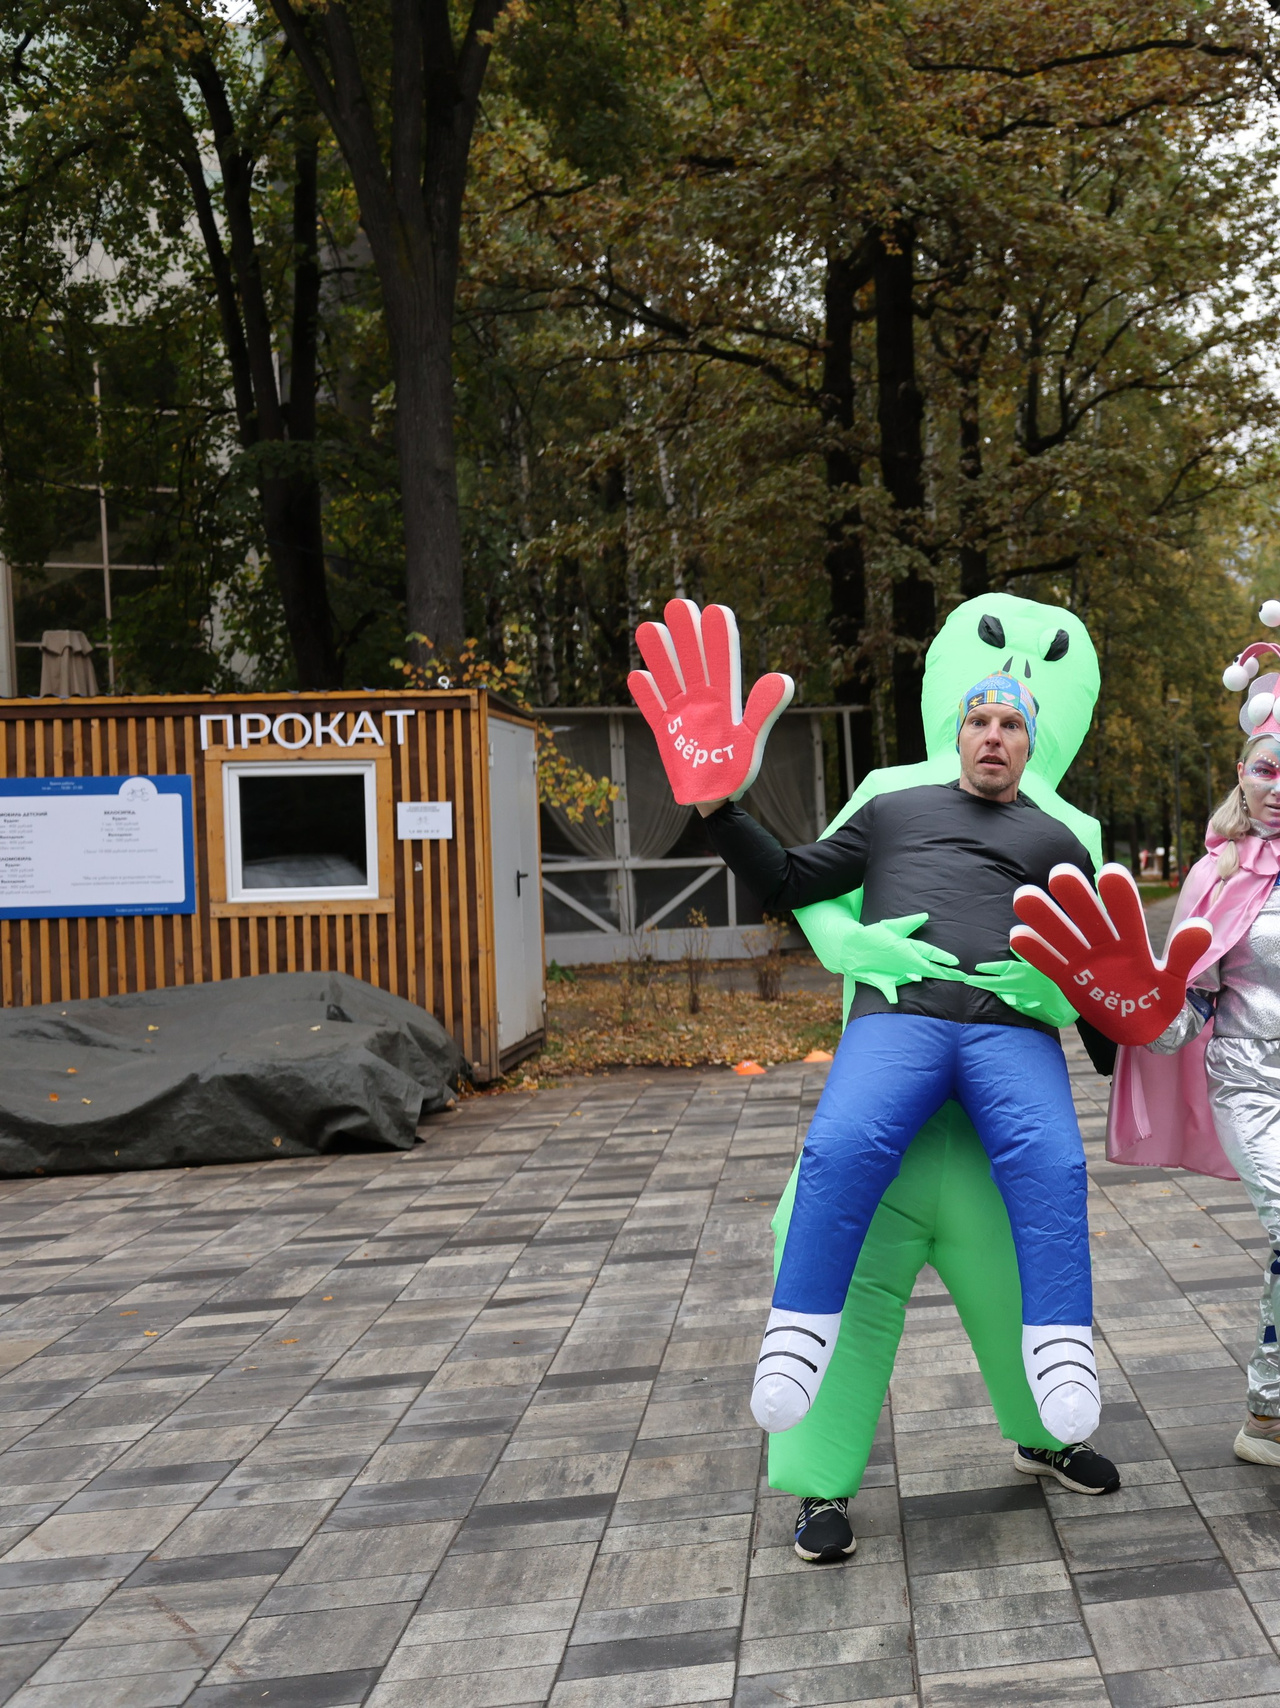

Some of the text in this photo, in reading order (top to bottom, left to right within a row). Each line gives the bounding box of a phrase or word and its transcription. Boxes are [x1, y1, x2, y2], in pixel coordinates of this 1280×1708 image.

[200, 709, 415, 750] ПРОКАТ
[668, 716, 734, 768] 5 вёрст
[1073, 969, 1161, 1017] 5 вёрст
